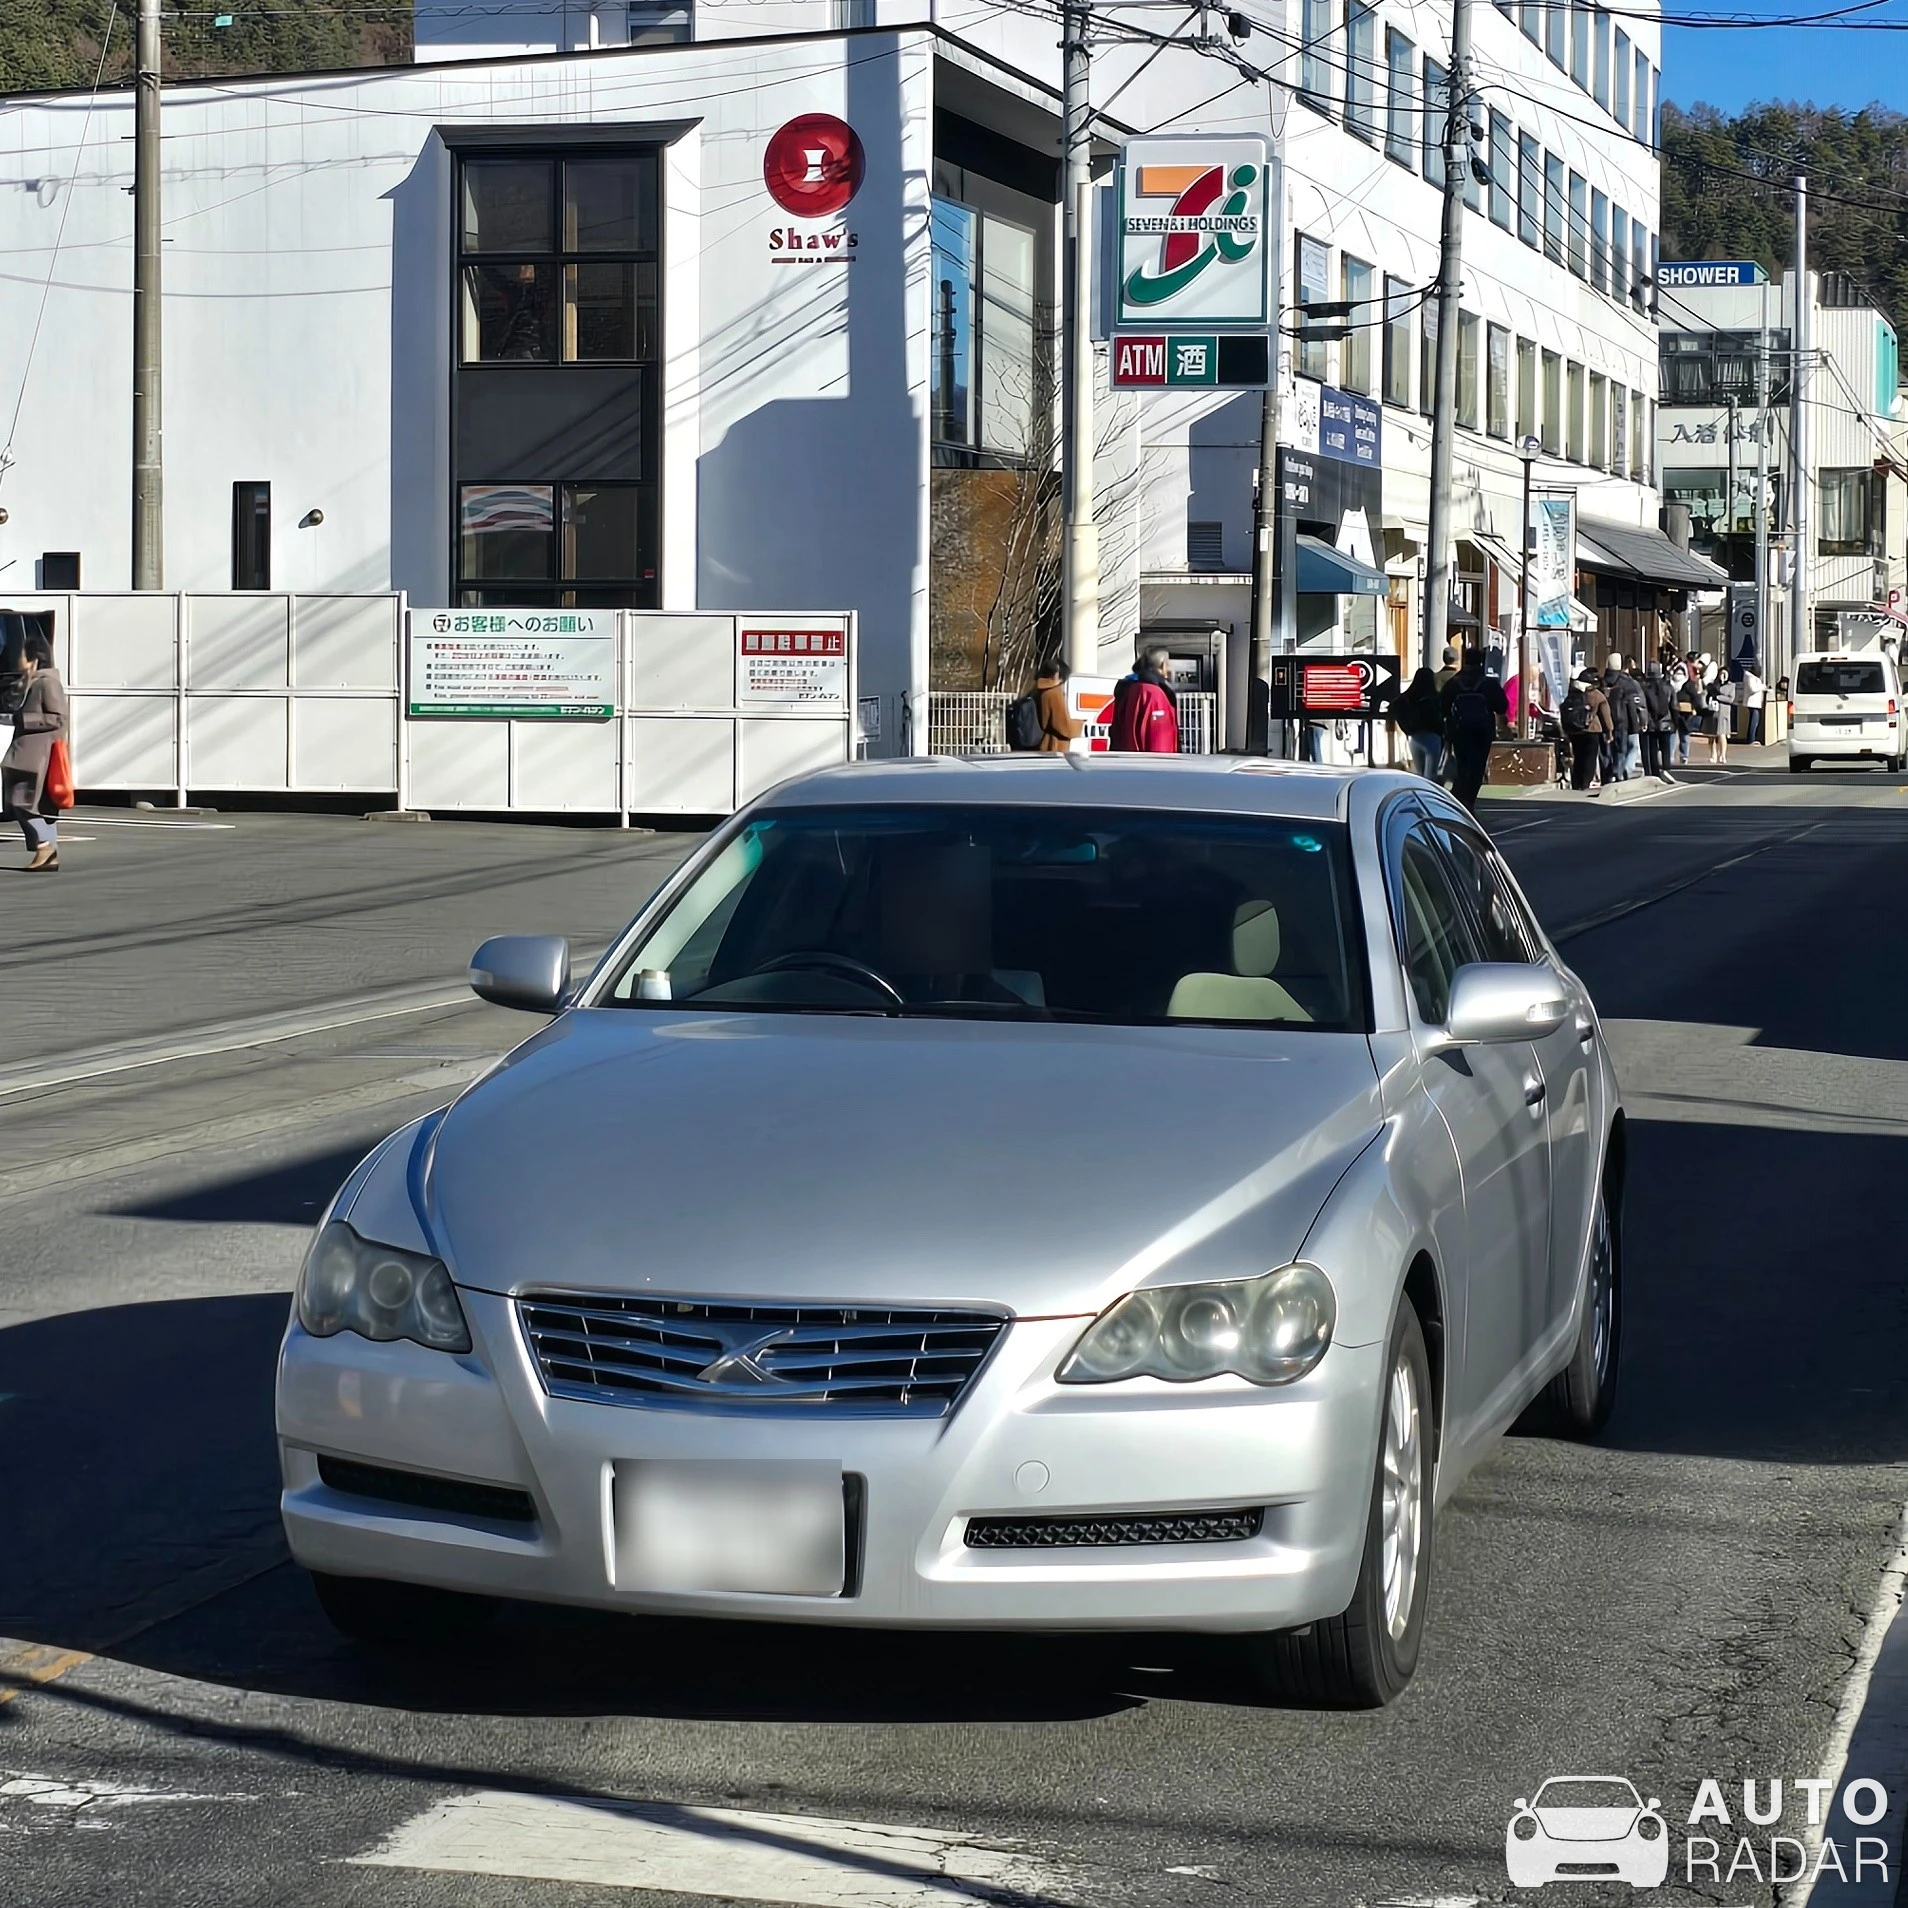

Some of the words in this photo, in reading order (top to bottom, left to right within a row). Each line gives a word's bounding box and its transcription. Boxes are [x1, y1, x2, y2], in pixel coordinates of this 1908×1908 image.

[1188, 217, 1257, 231] HOLDINGS
[1657, 266, 1740, 285] SHOWER
[1118, 344, 1164, 376] ATM
[1176, 345, 1207, 376] 酒
